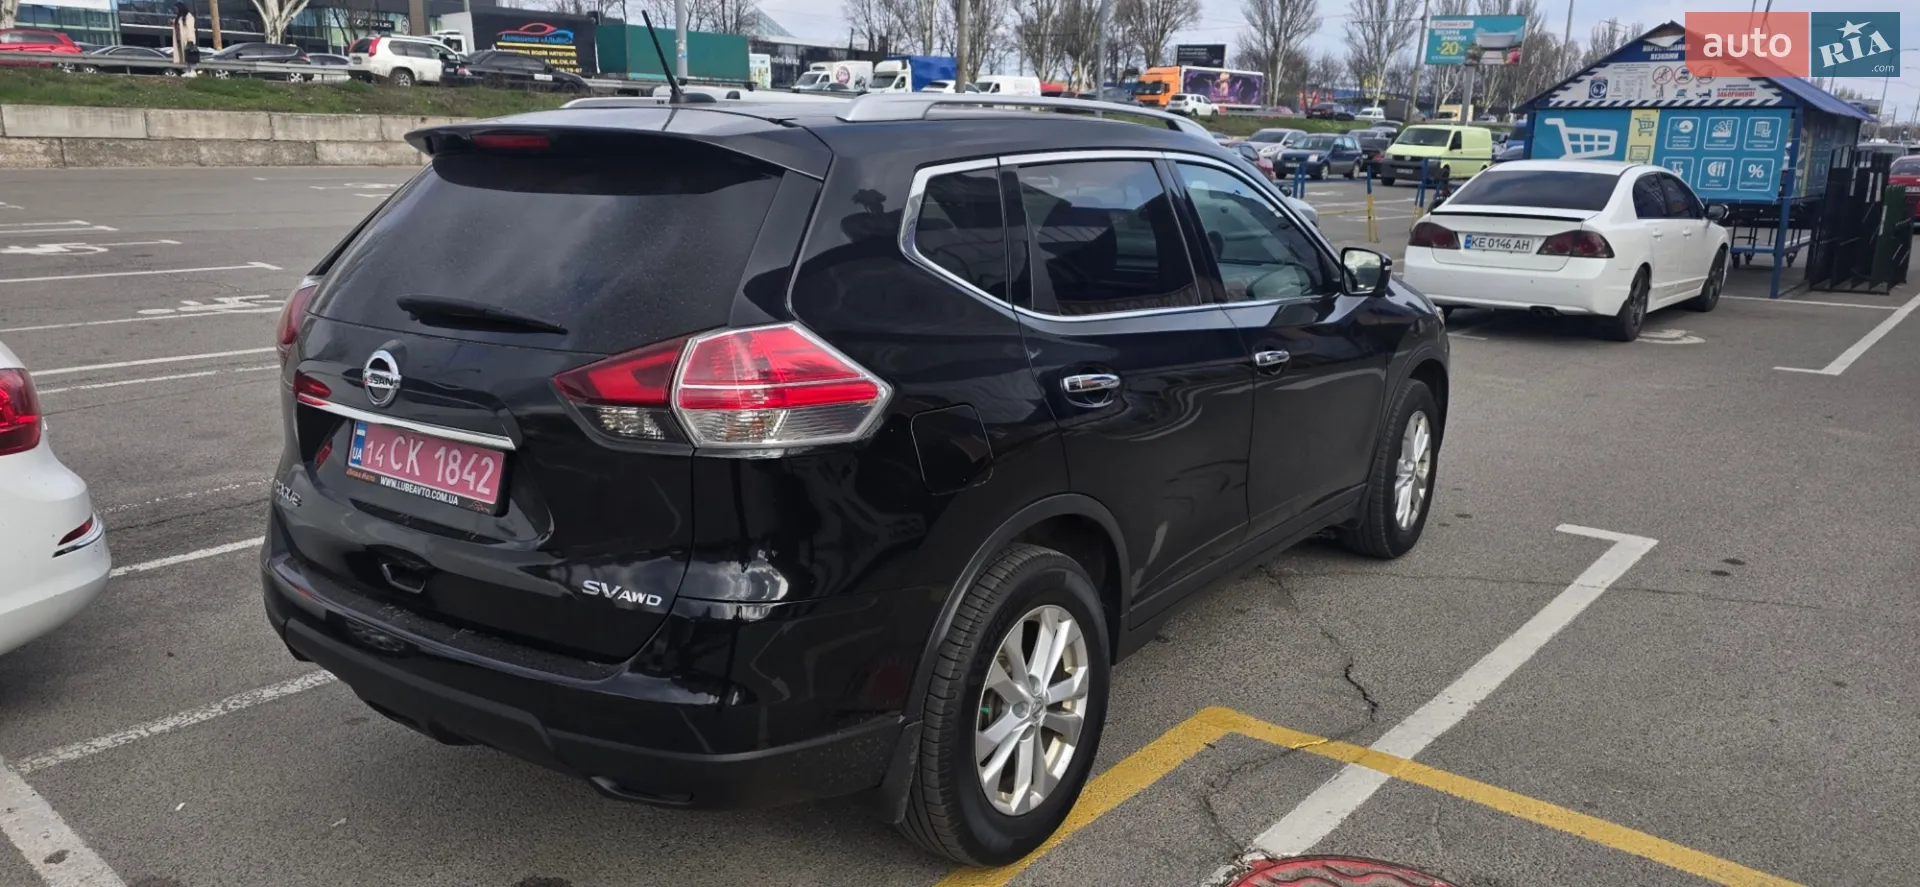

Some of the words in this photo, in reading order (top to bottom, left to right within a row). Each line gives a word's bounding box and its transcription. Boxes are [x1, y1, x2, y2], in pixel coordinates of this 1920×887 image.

[1471, 237, 1487, 247] KE
[1488, 238, 1511, 249] 0146
[1513, 239, 1530, 250] AH
[352, 446, 362, 461] UA
[366, 440, 386, 468] 14
[390, 435, 425, 477] CK
[434, 445, 495, 496] 1842
[379, 475, 459, 506] WWW.LUBEAVTO.COM.UA
[582, 580, 622, 598] SV
[618, 590, 662, 606] AWD
